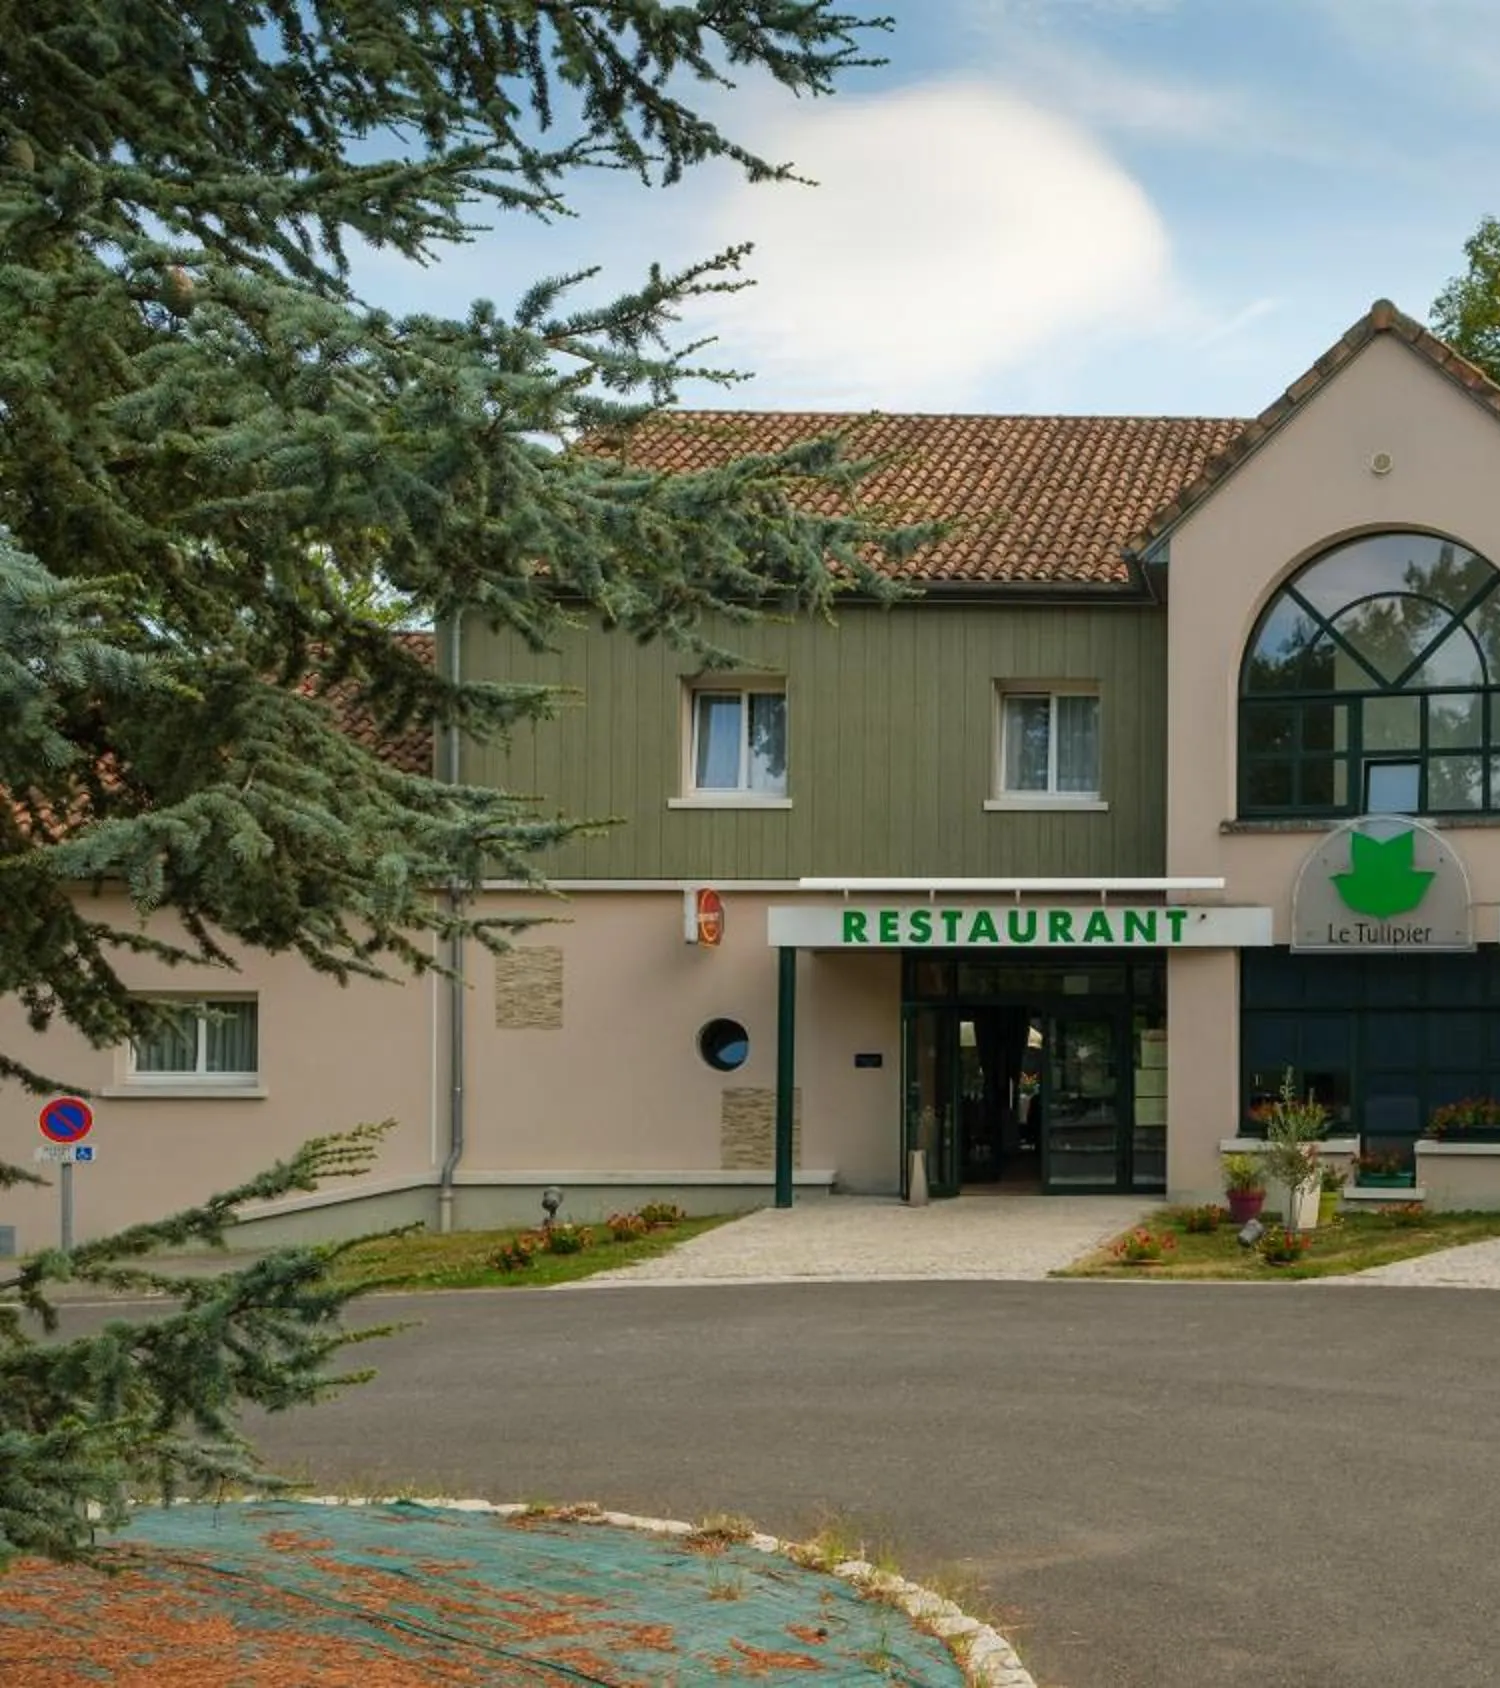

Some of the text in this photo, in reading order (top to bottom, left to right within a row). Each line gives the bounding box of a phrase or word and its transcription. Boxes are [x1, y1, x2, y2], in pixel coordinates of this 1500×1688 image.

[842, 910, 1187, 942] RESTAURANT
[1327, 922, 1432, 946] Le Tulipier
